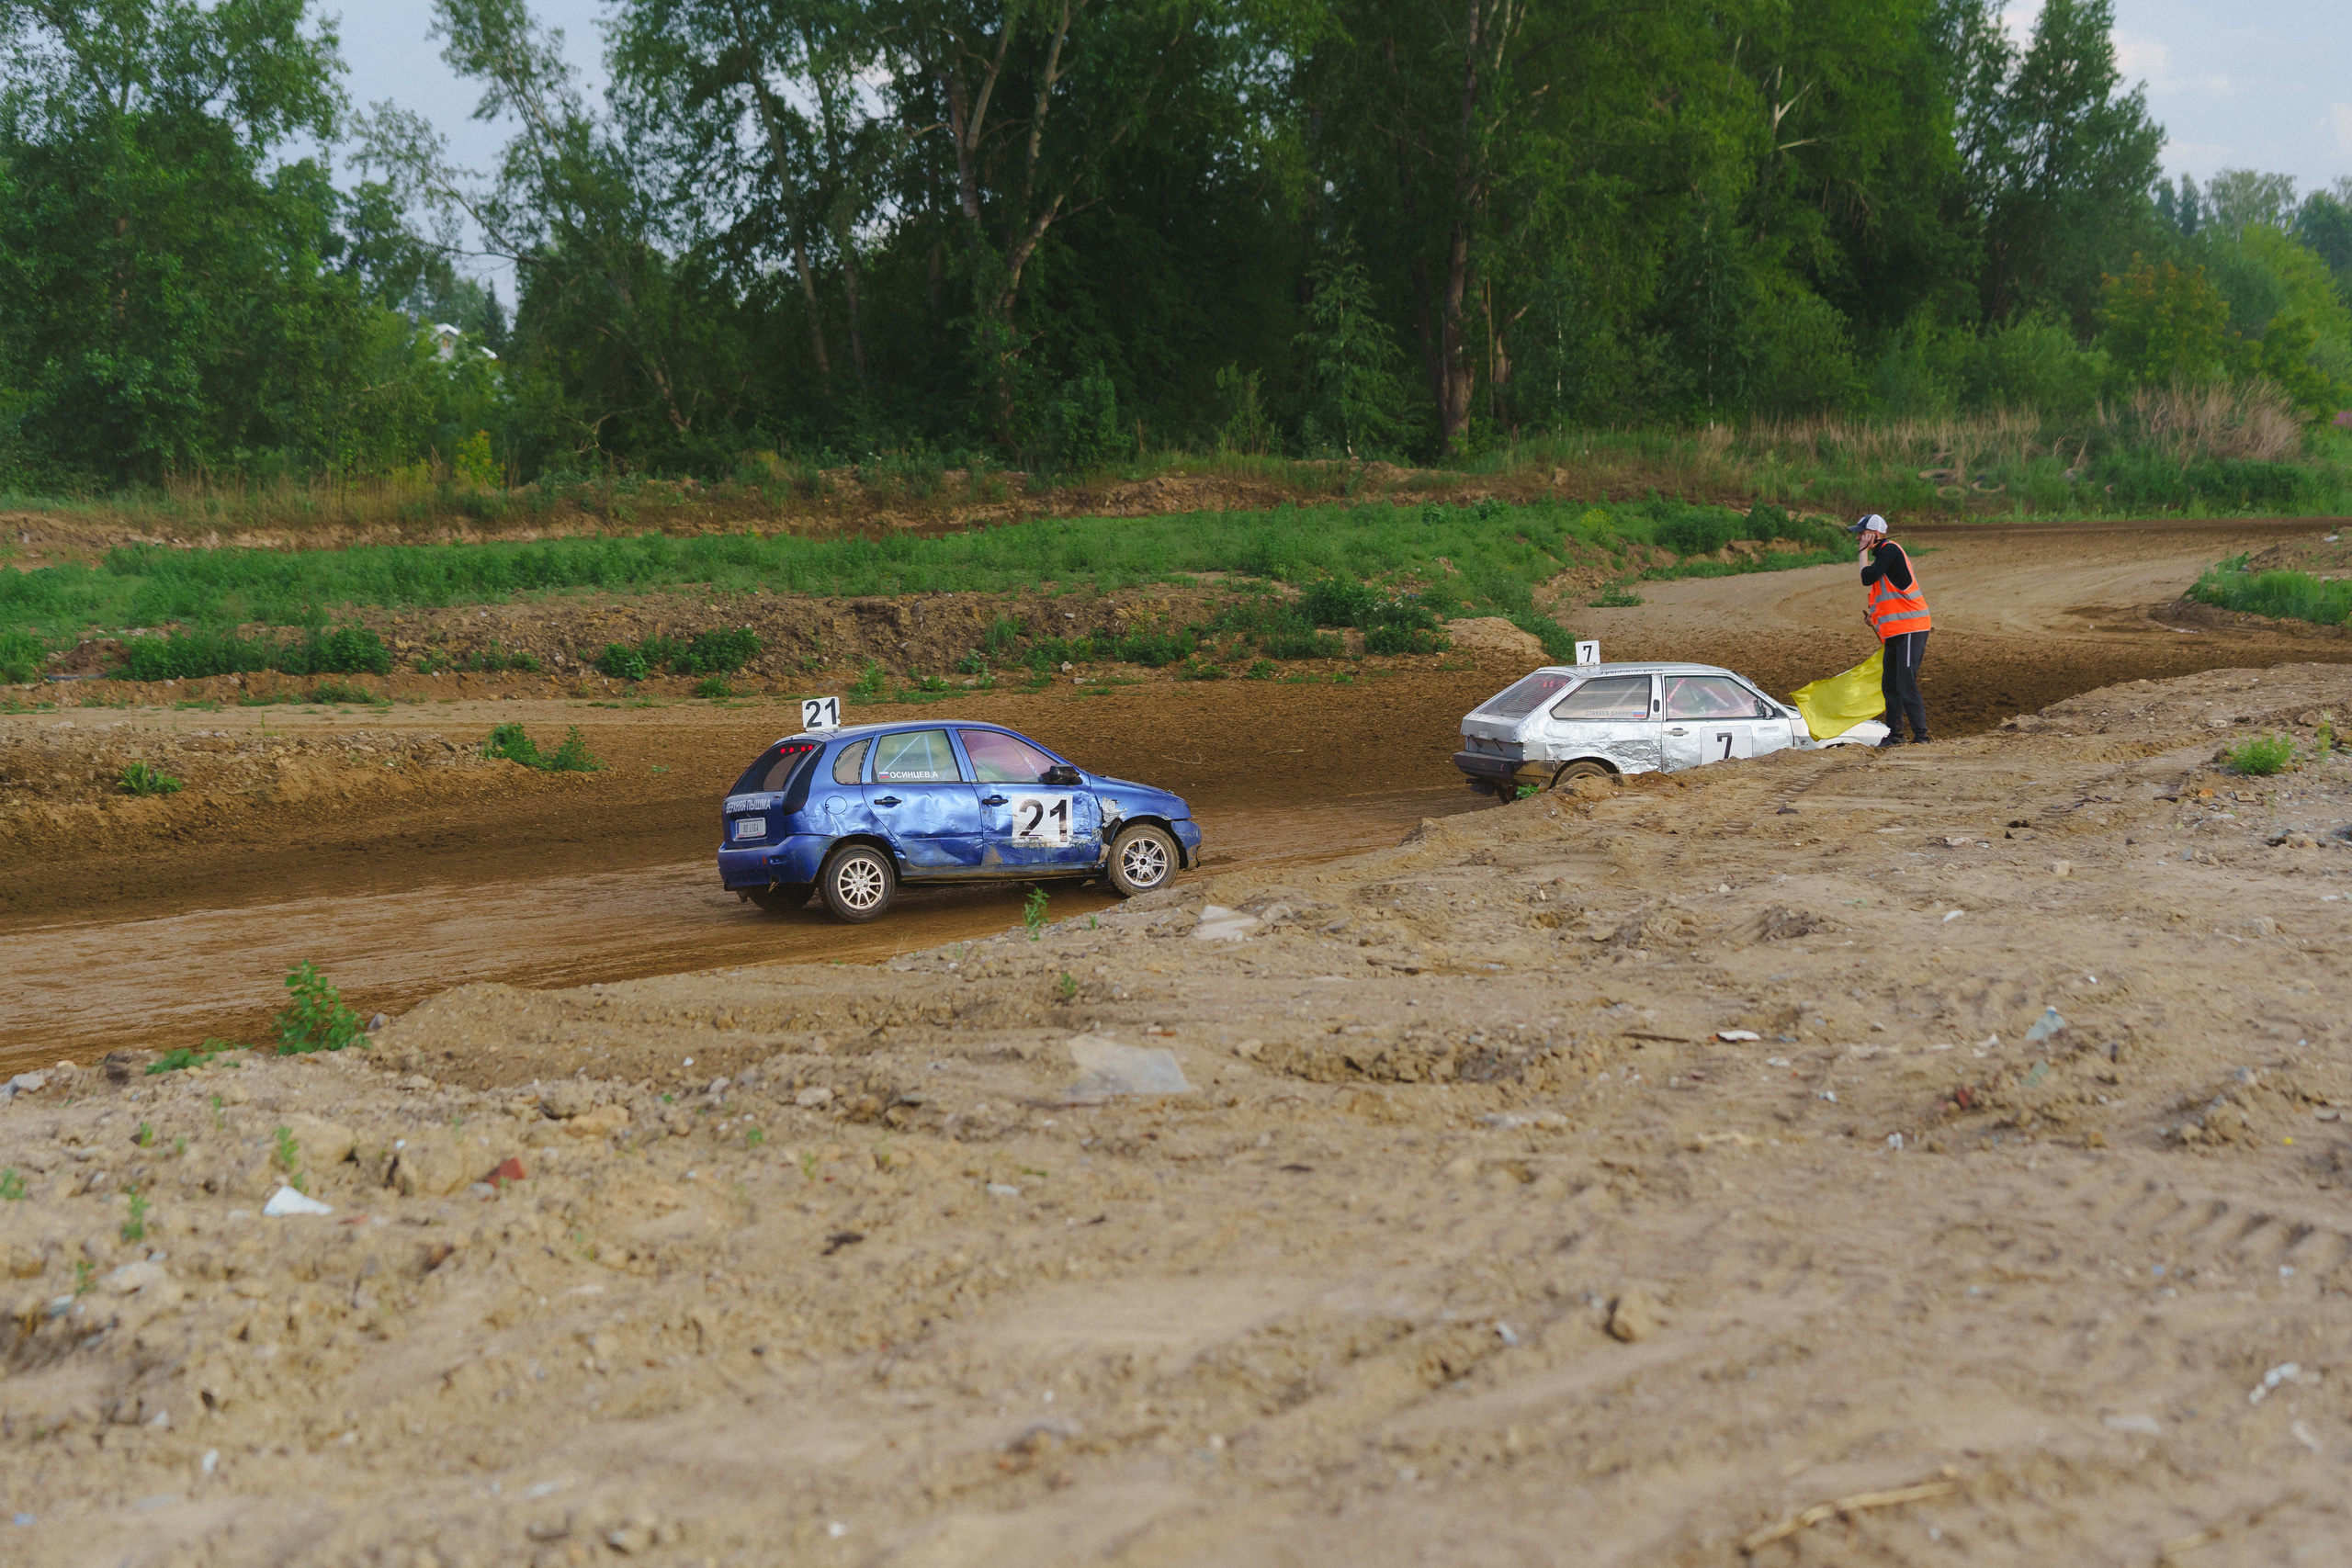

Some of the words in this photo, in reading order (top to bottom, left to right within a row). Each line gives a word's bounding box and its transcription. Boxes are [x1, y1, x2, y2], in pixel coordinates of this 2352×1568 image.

[1583, 645, 1592, 662] 7
[806, 698, 837, 728] 21
[1716, 732, 1733, 760] 7
[1020, 798, 1068, 842] 21
